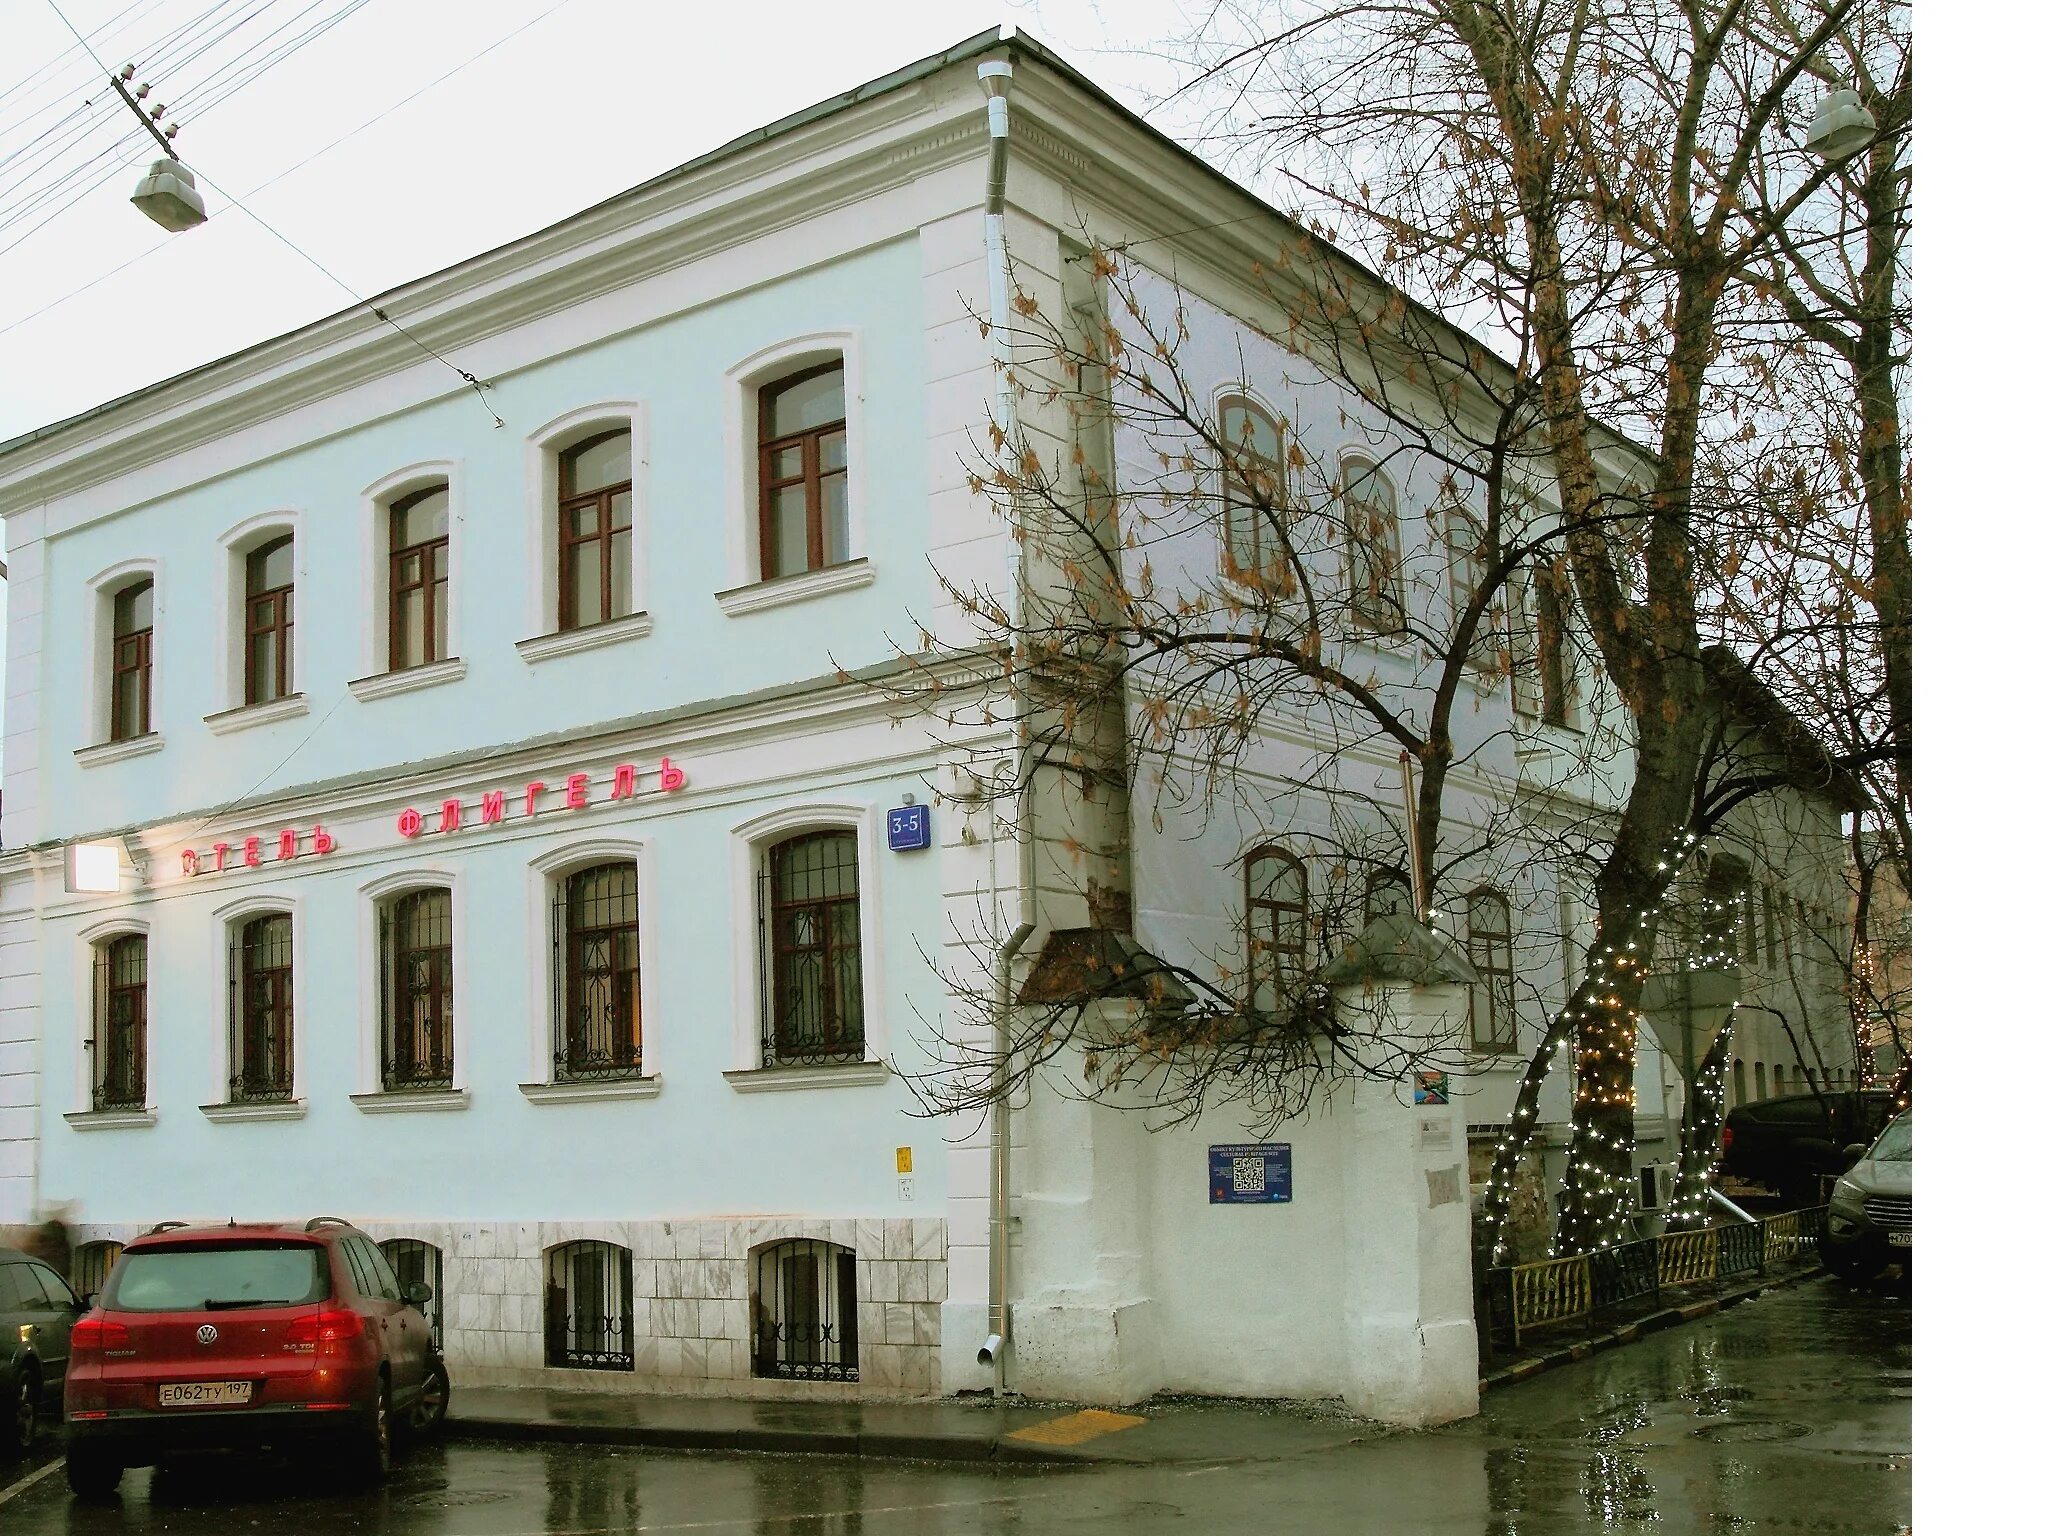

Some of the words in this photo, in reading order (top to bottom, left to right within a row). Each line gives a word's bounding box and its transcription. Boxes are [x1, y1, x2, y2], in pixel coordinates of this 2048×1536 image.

[181, 825, 333, 875] ОТЕЛЬ
[398, 757, 684, 837] ФЛИГЕЛЬ
[892, 814, 918, 833] 3-5
